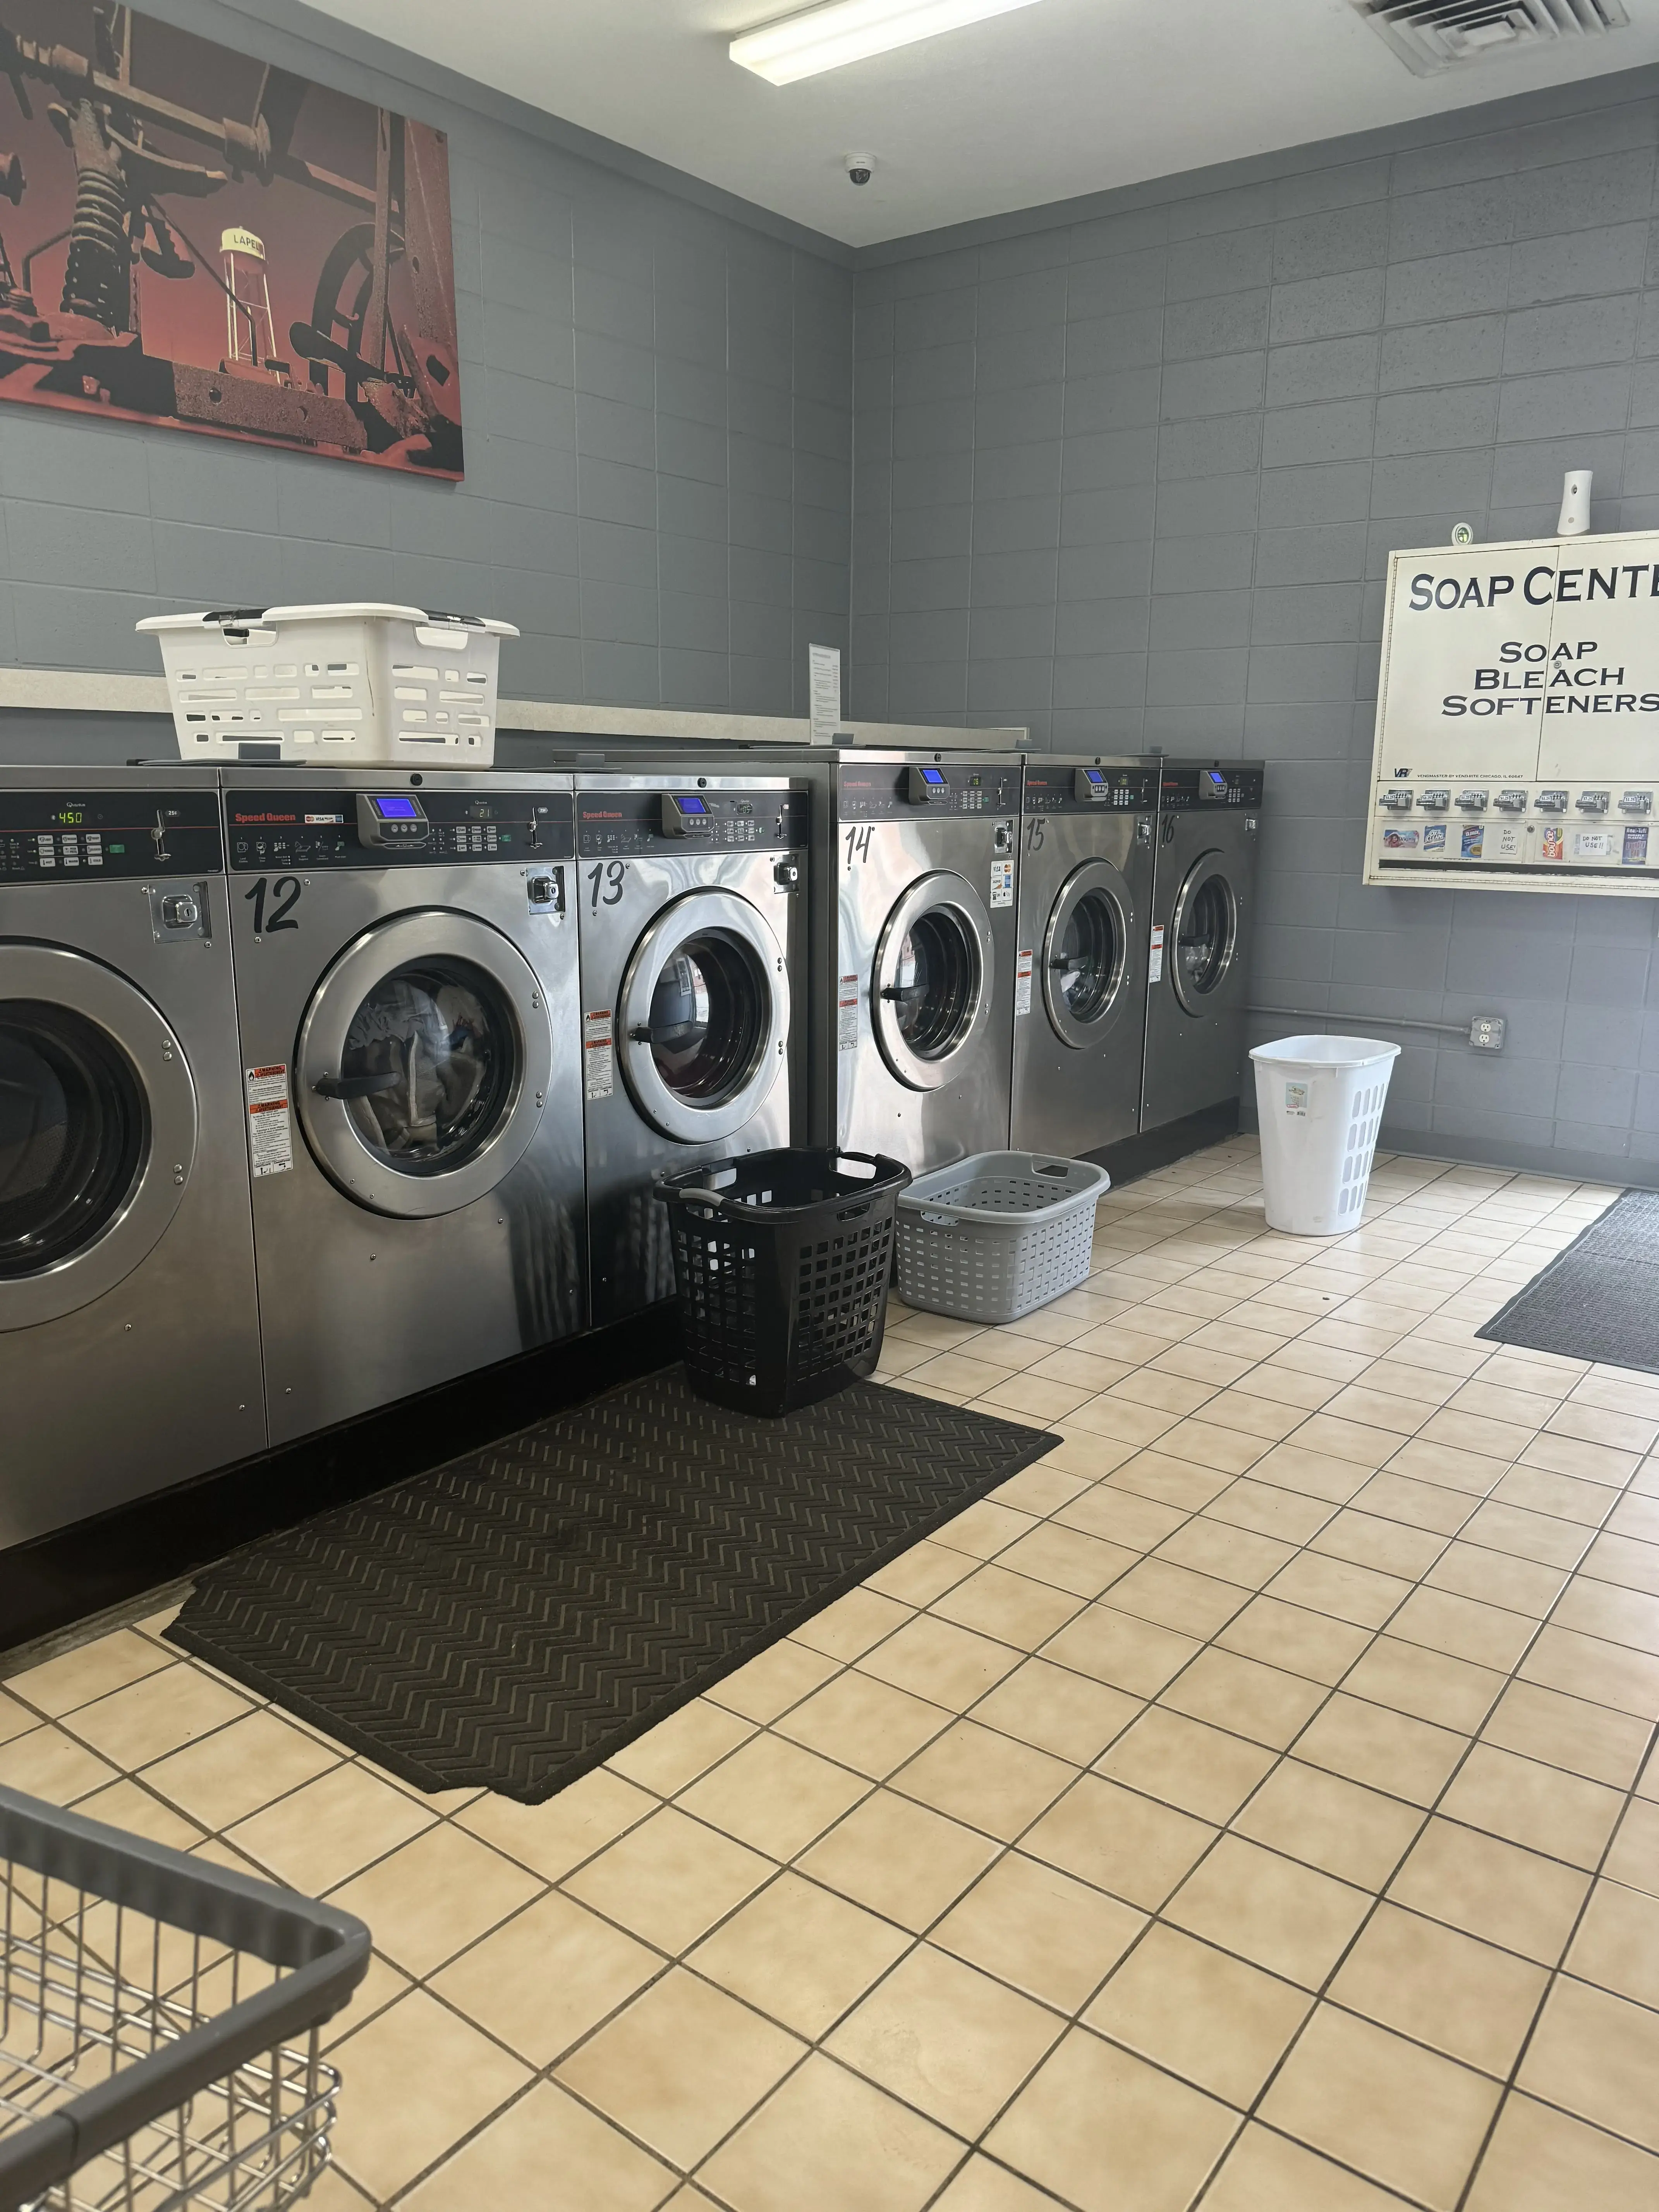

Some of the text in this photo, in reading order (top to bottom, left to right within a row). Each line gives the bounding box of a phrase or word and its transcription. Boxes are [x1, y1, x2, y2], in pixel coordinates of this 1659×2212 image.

[1409, 573, 1514, 611] SOAP
[1499, 641, 1598, 663] SOAP
[1474, 667, 1625, 690] BLEACH
[1441, 693, 1659, 716] SOFTENERS
[59, 812, 82, 823] 450
[235, 813, 296, 823] Speed Queen
[479, 809, 489, 817] 21
[1027, 818, 1046, 851] 15
[1162, 814, 1175, 843] 16
[845, 826, 871, 864] 14
[1547, 831, 1556, 857] bounce
[587, 860, 625, 907] 13
[245, 876, 301, 933] 12
